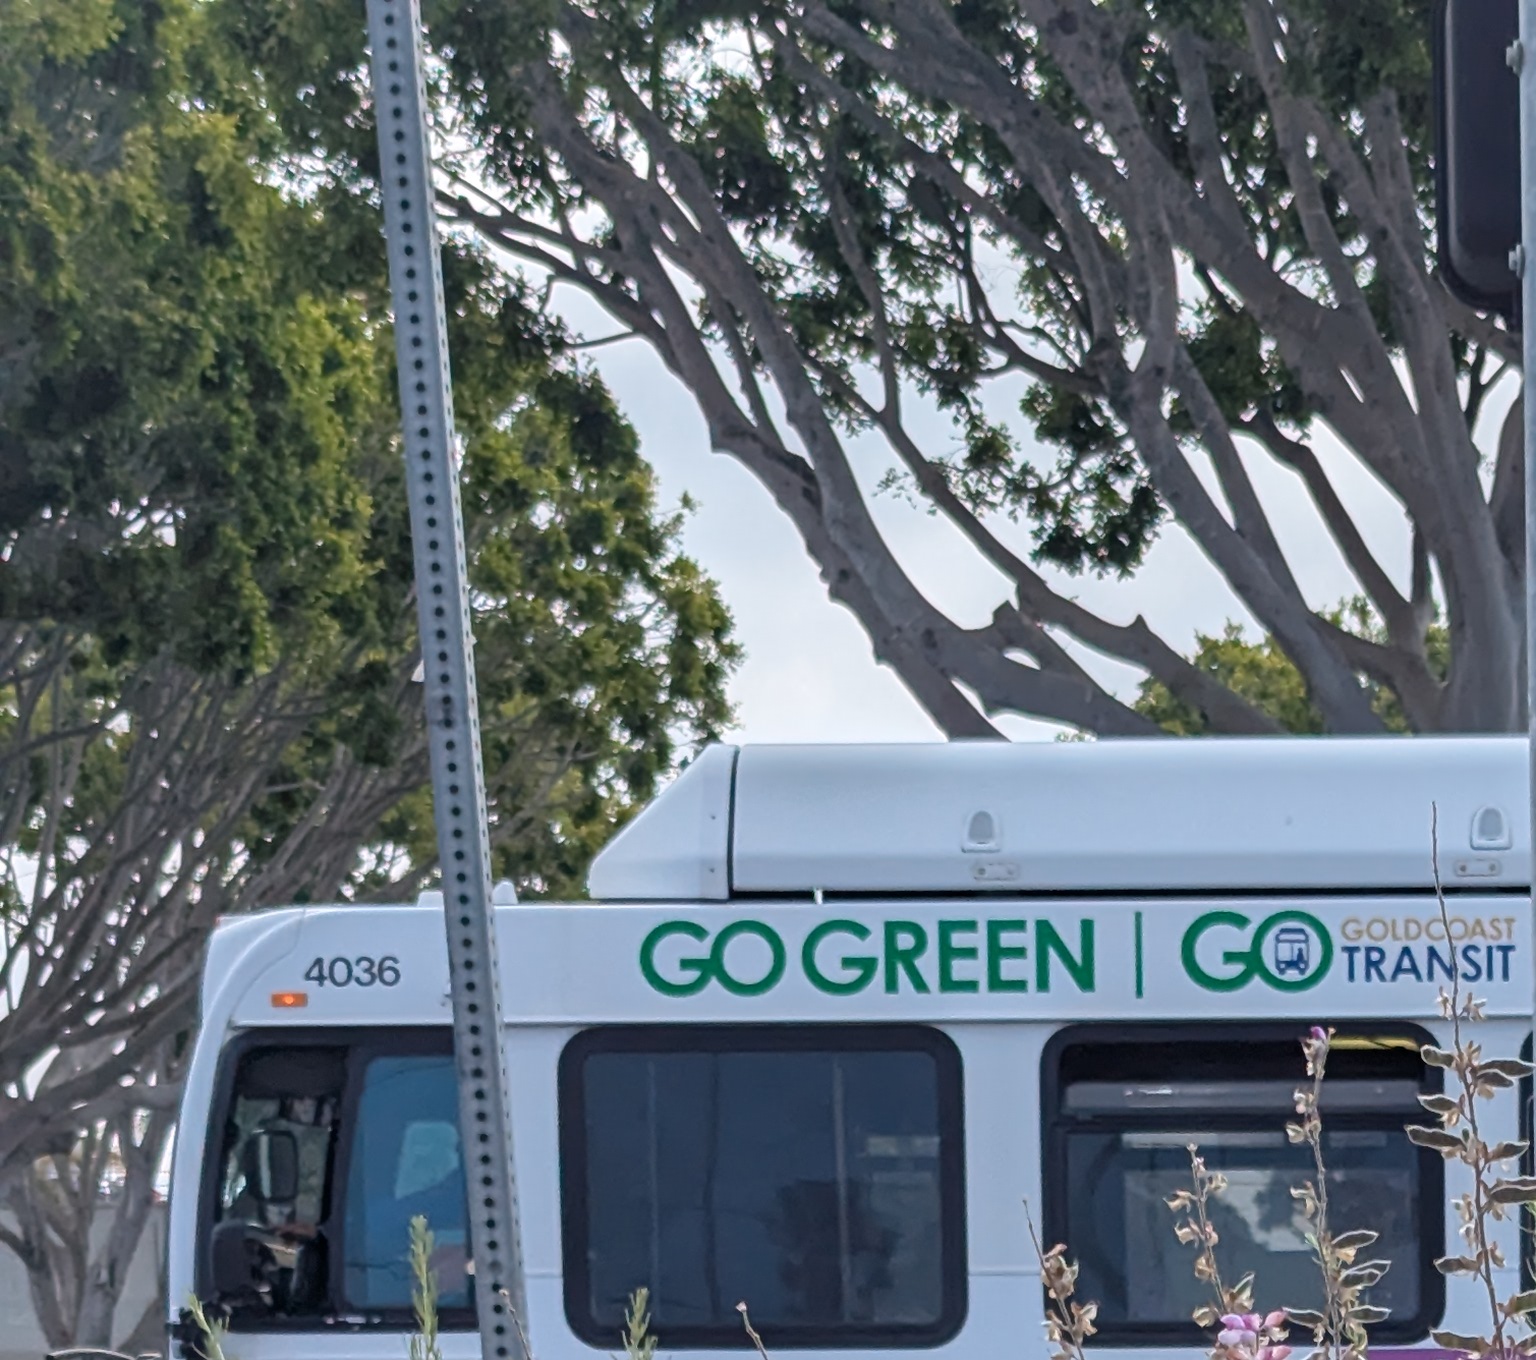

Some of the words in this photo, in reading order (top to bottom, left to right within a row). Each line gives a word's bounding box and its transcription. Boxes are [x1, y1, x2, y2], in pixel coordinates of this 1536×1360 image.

[304, 956, 401, 988] 4036
[639, 919, 787, 997] GO
[801, 918, 1096, 997] GREEN
[1181, 910, 1333, 993] GO
[1340, 944, 1516, 983] TRANSIT
